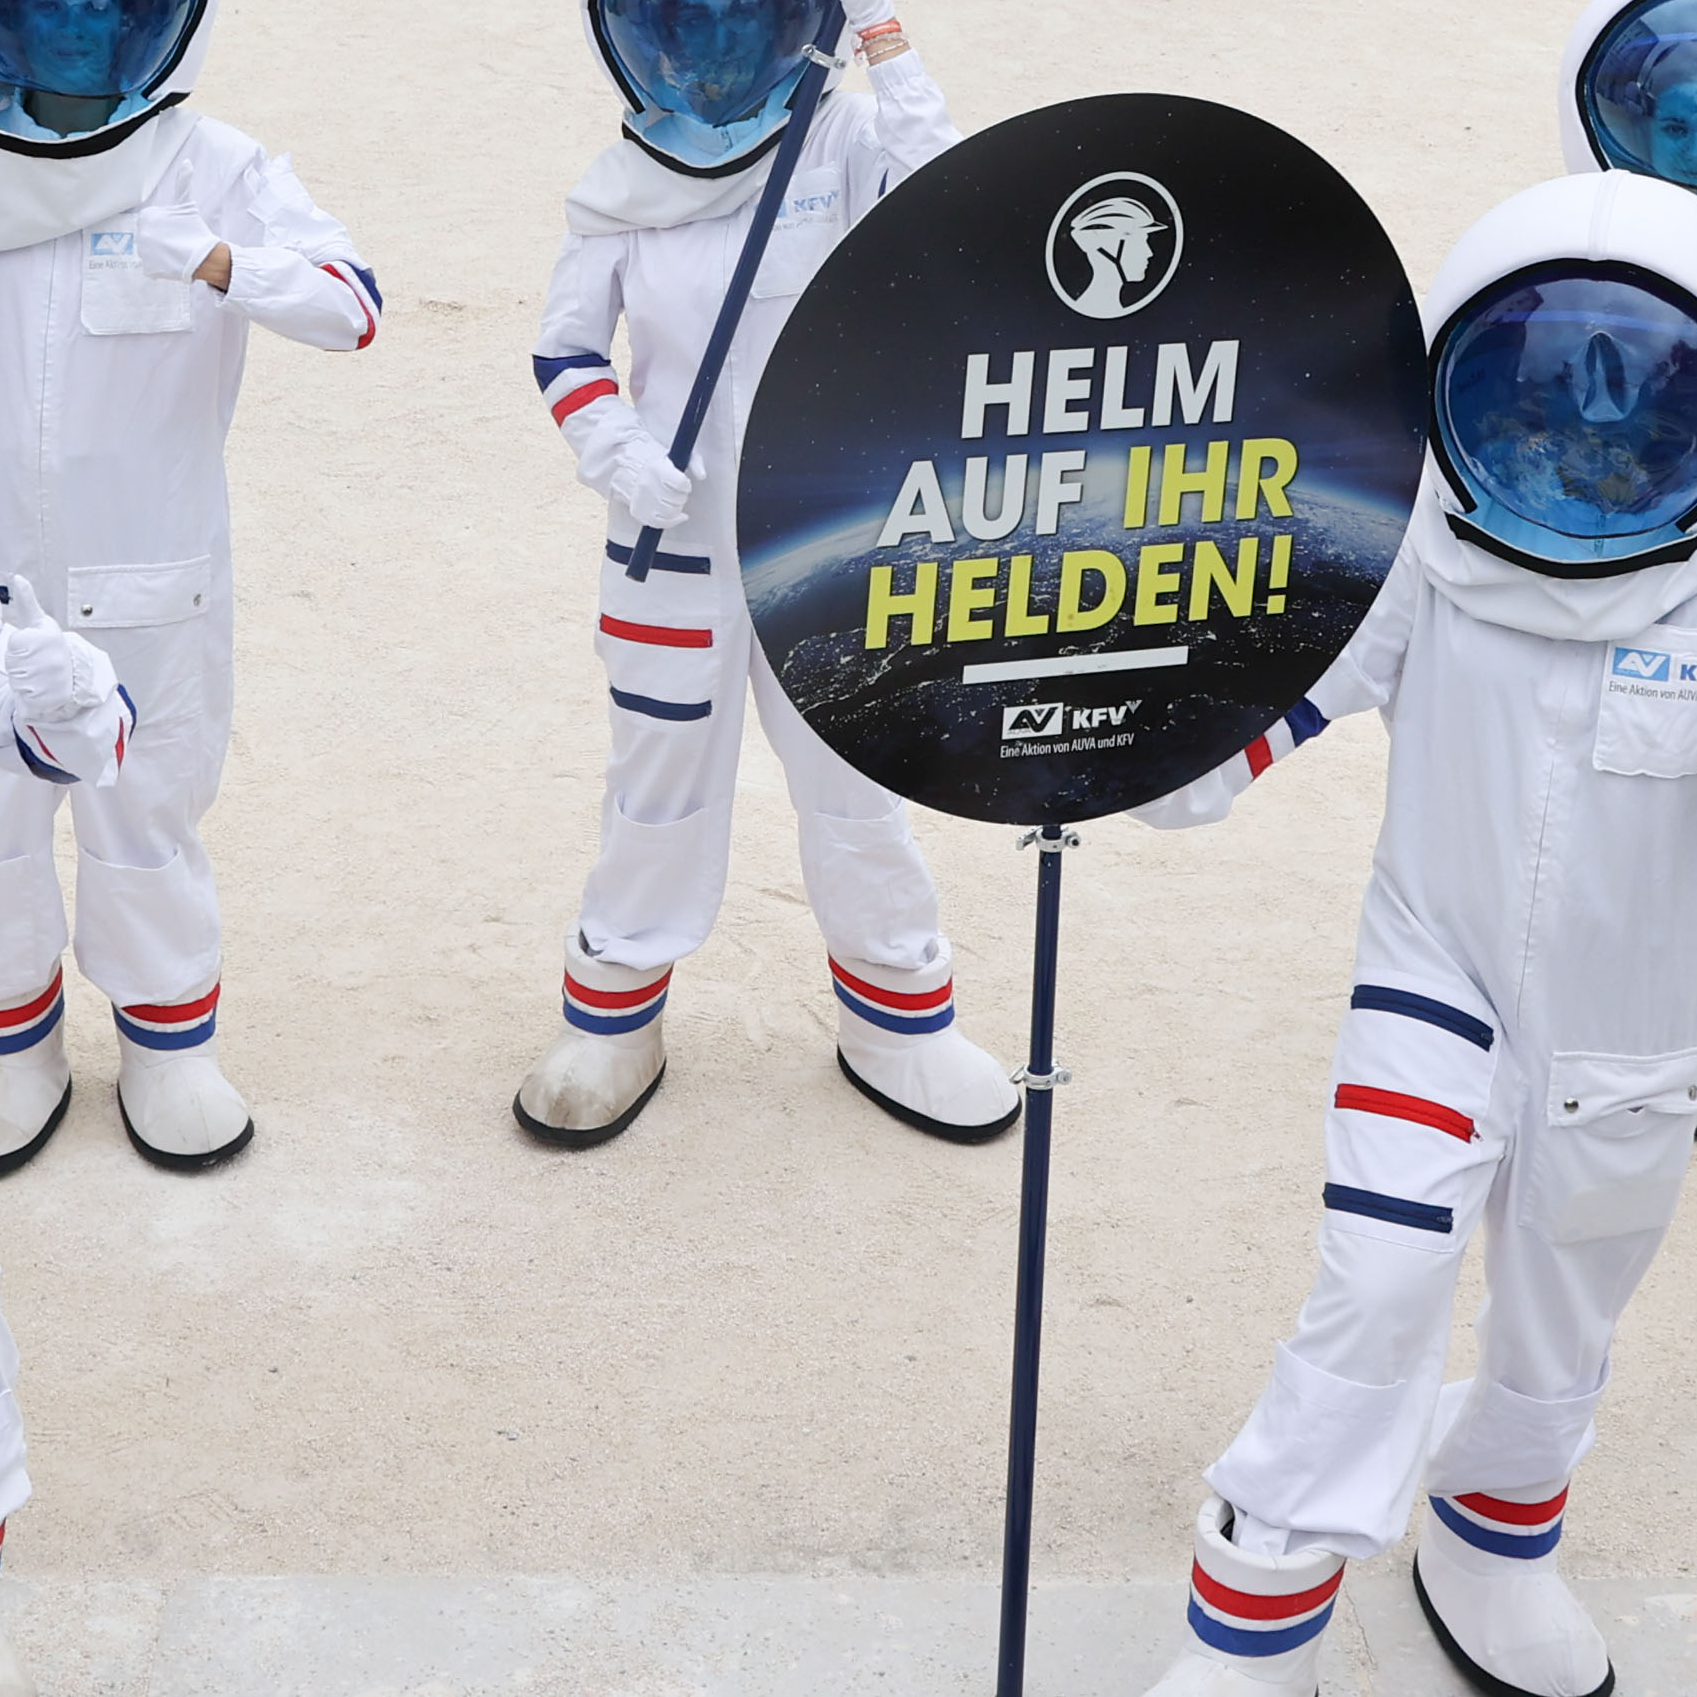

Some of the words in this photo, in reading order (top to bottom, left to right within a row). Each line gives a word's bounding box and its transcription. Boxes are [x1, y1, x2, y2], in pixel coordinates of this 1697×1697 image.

[961, 339, 1240, 439] HELM
[876, 450, 1087, 548] AUF
[1123, 437, 1299, 531] IHR
[864, 535, 1293, 651] HELDEN!
[1072, 705, 1127, 730] KFV
[1609, 681, 1628, 692] Eine
[1629, 684, 1658, 697] Aktion
[1659, 691, 1675, 700] von
[1000, 745, 1020, 758] Eine
[1021, 742, 1051, 756] Aktion
[1052, 741, 1070, 753] von
[1071, 737, 1096, 751] AUVA
[1097, 735, 1115, 748] und
[1116, 733, 1135, 747] KFV
